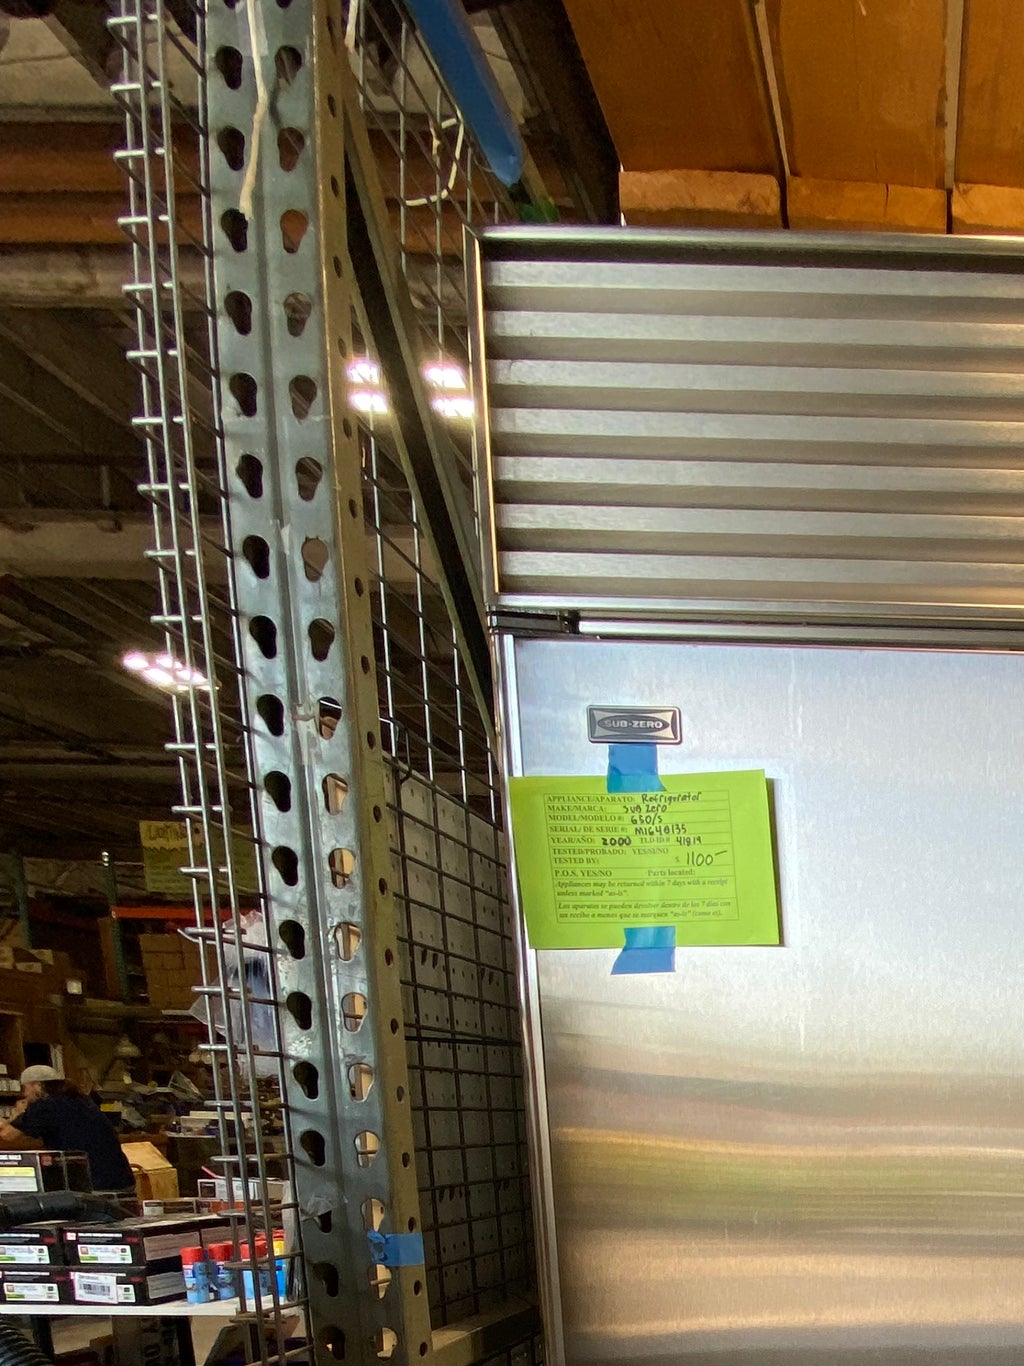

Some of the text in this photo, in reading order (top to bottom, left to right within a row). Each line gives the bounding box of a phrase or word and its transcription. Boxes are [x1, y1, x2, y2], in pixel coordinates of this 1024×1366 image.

[641, 791, 702, 806] Refrigerator
[547, 804, 607, 812] MAKE/MARCA:
[548, 814, 616, 822] MODEL/MODELO
[549, 825, 582, 833] SERIAL/
[602, 836, 632, 847] 2000
[580, 869, 613, 877] YES/NO
